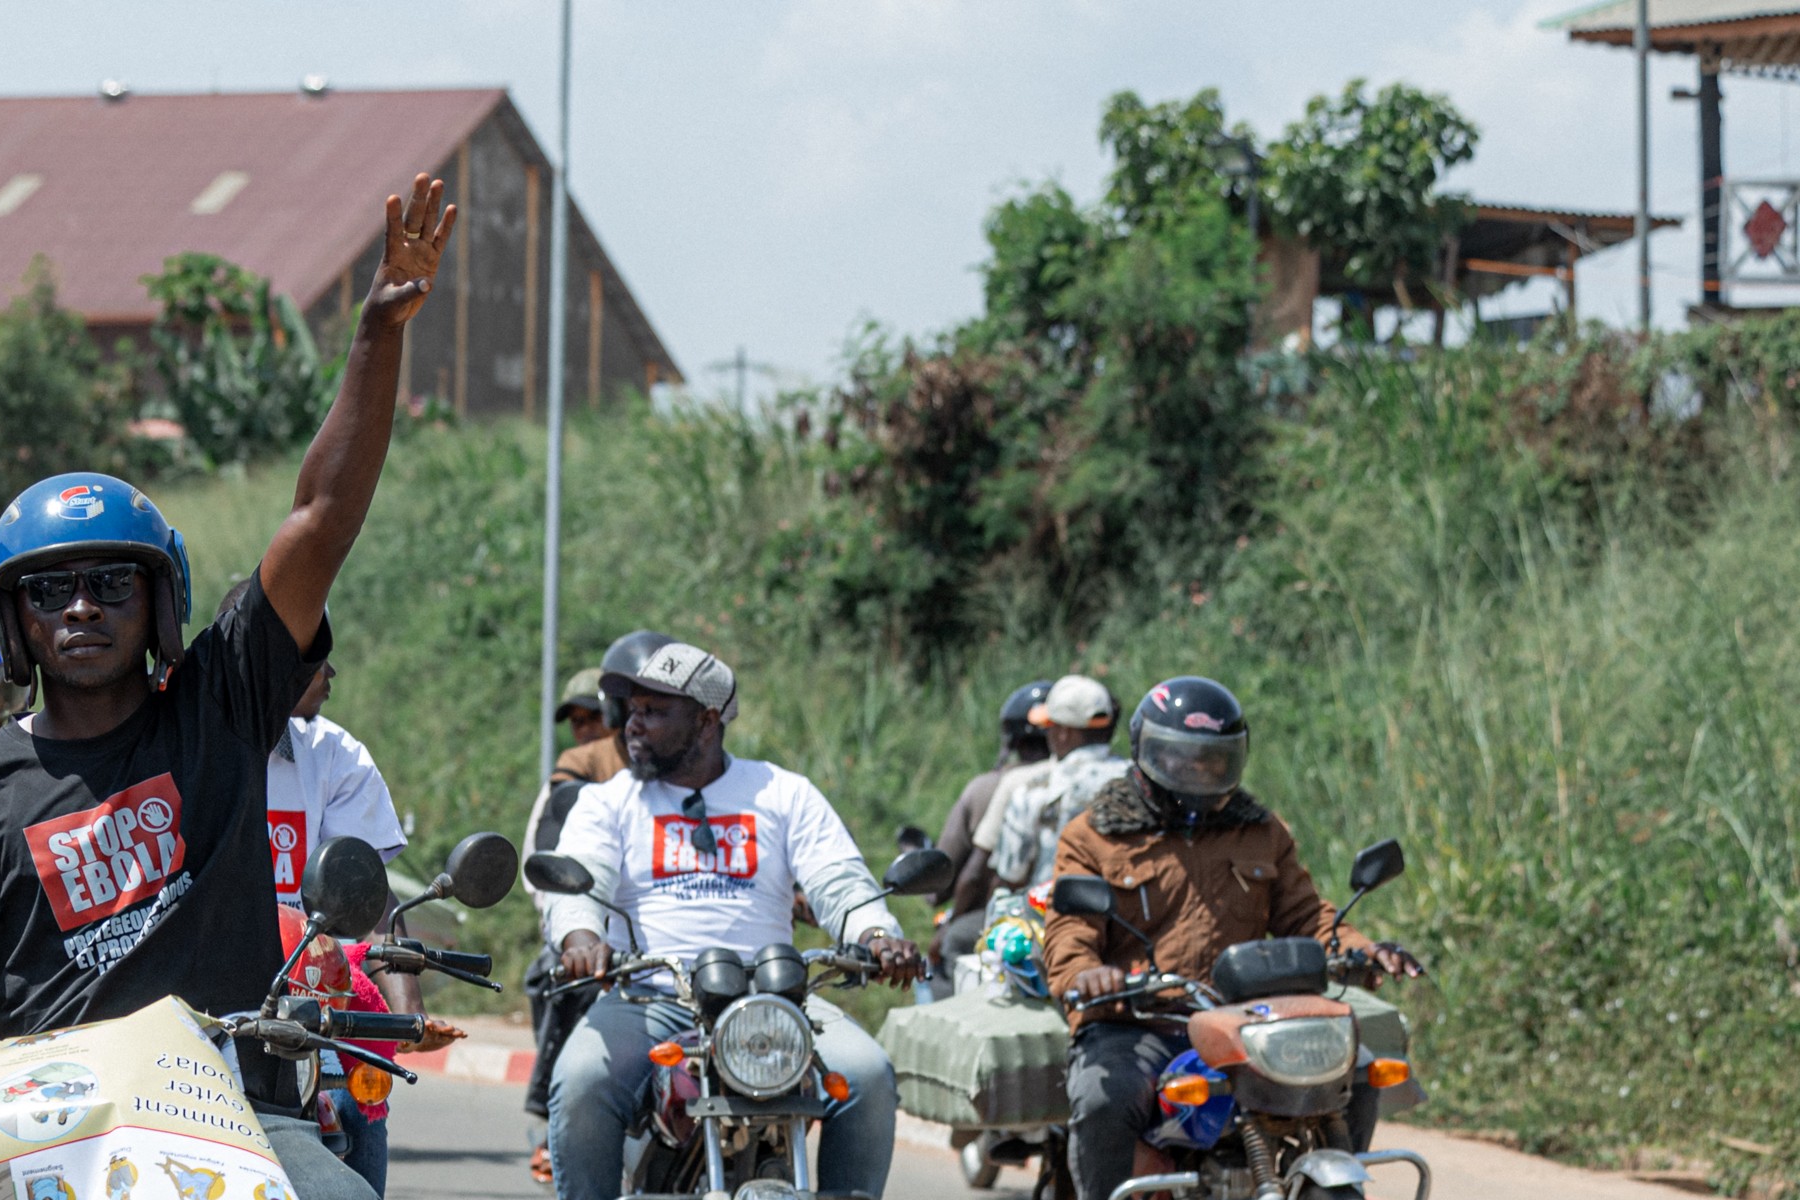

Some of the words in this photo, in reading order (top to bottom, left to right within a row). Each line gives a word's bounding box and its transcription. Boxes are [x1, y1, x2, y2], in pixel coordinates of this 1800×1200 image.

[48, 807, 138, 872] STOP
[664, 821, 725, 847] STP
[60, 831, 177, 913] EBOLA
[664, 845, 749, 874] EBOLA
[156, 1053, 235, 1093] bola?
[164, 1080, 244, 1114] éviter
[133, 1096, 271, 1150] Comment
[22, 1164, 64, 1177] Saignement
[199, 1156, 225, 1167] Fatigue
